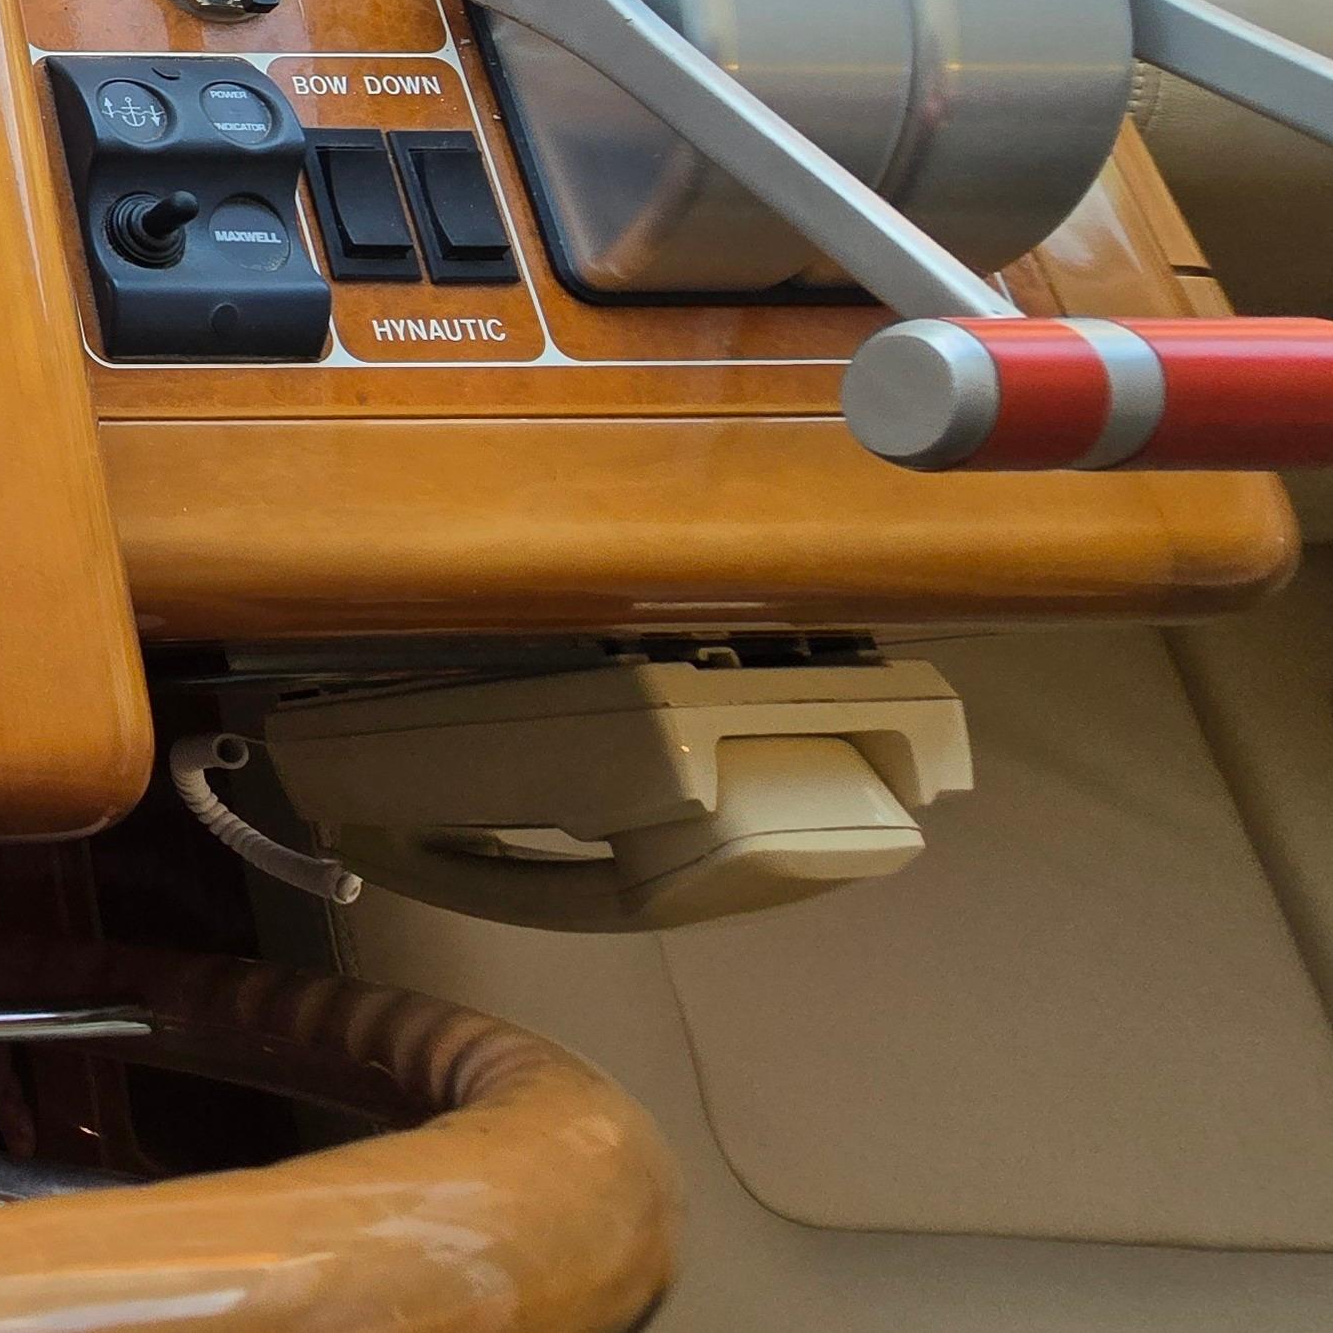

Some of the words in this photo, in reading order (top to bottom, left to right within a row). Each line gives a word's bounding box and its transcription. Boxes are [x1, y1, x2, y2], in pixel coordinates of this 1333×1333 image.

[292, 76, 349, 95] BOW
[366, 77, 441, 95] DOWN
[210, 90, 248, 99] POWER
[214, 231, 282, 244] MAXWELL
[372, 319, 507, 342] HYNAUTIC
